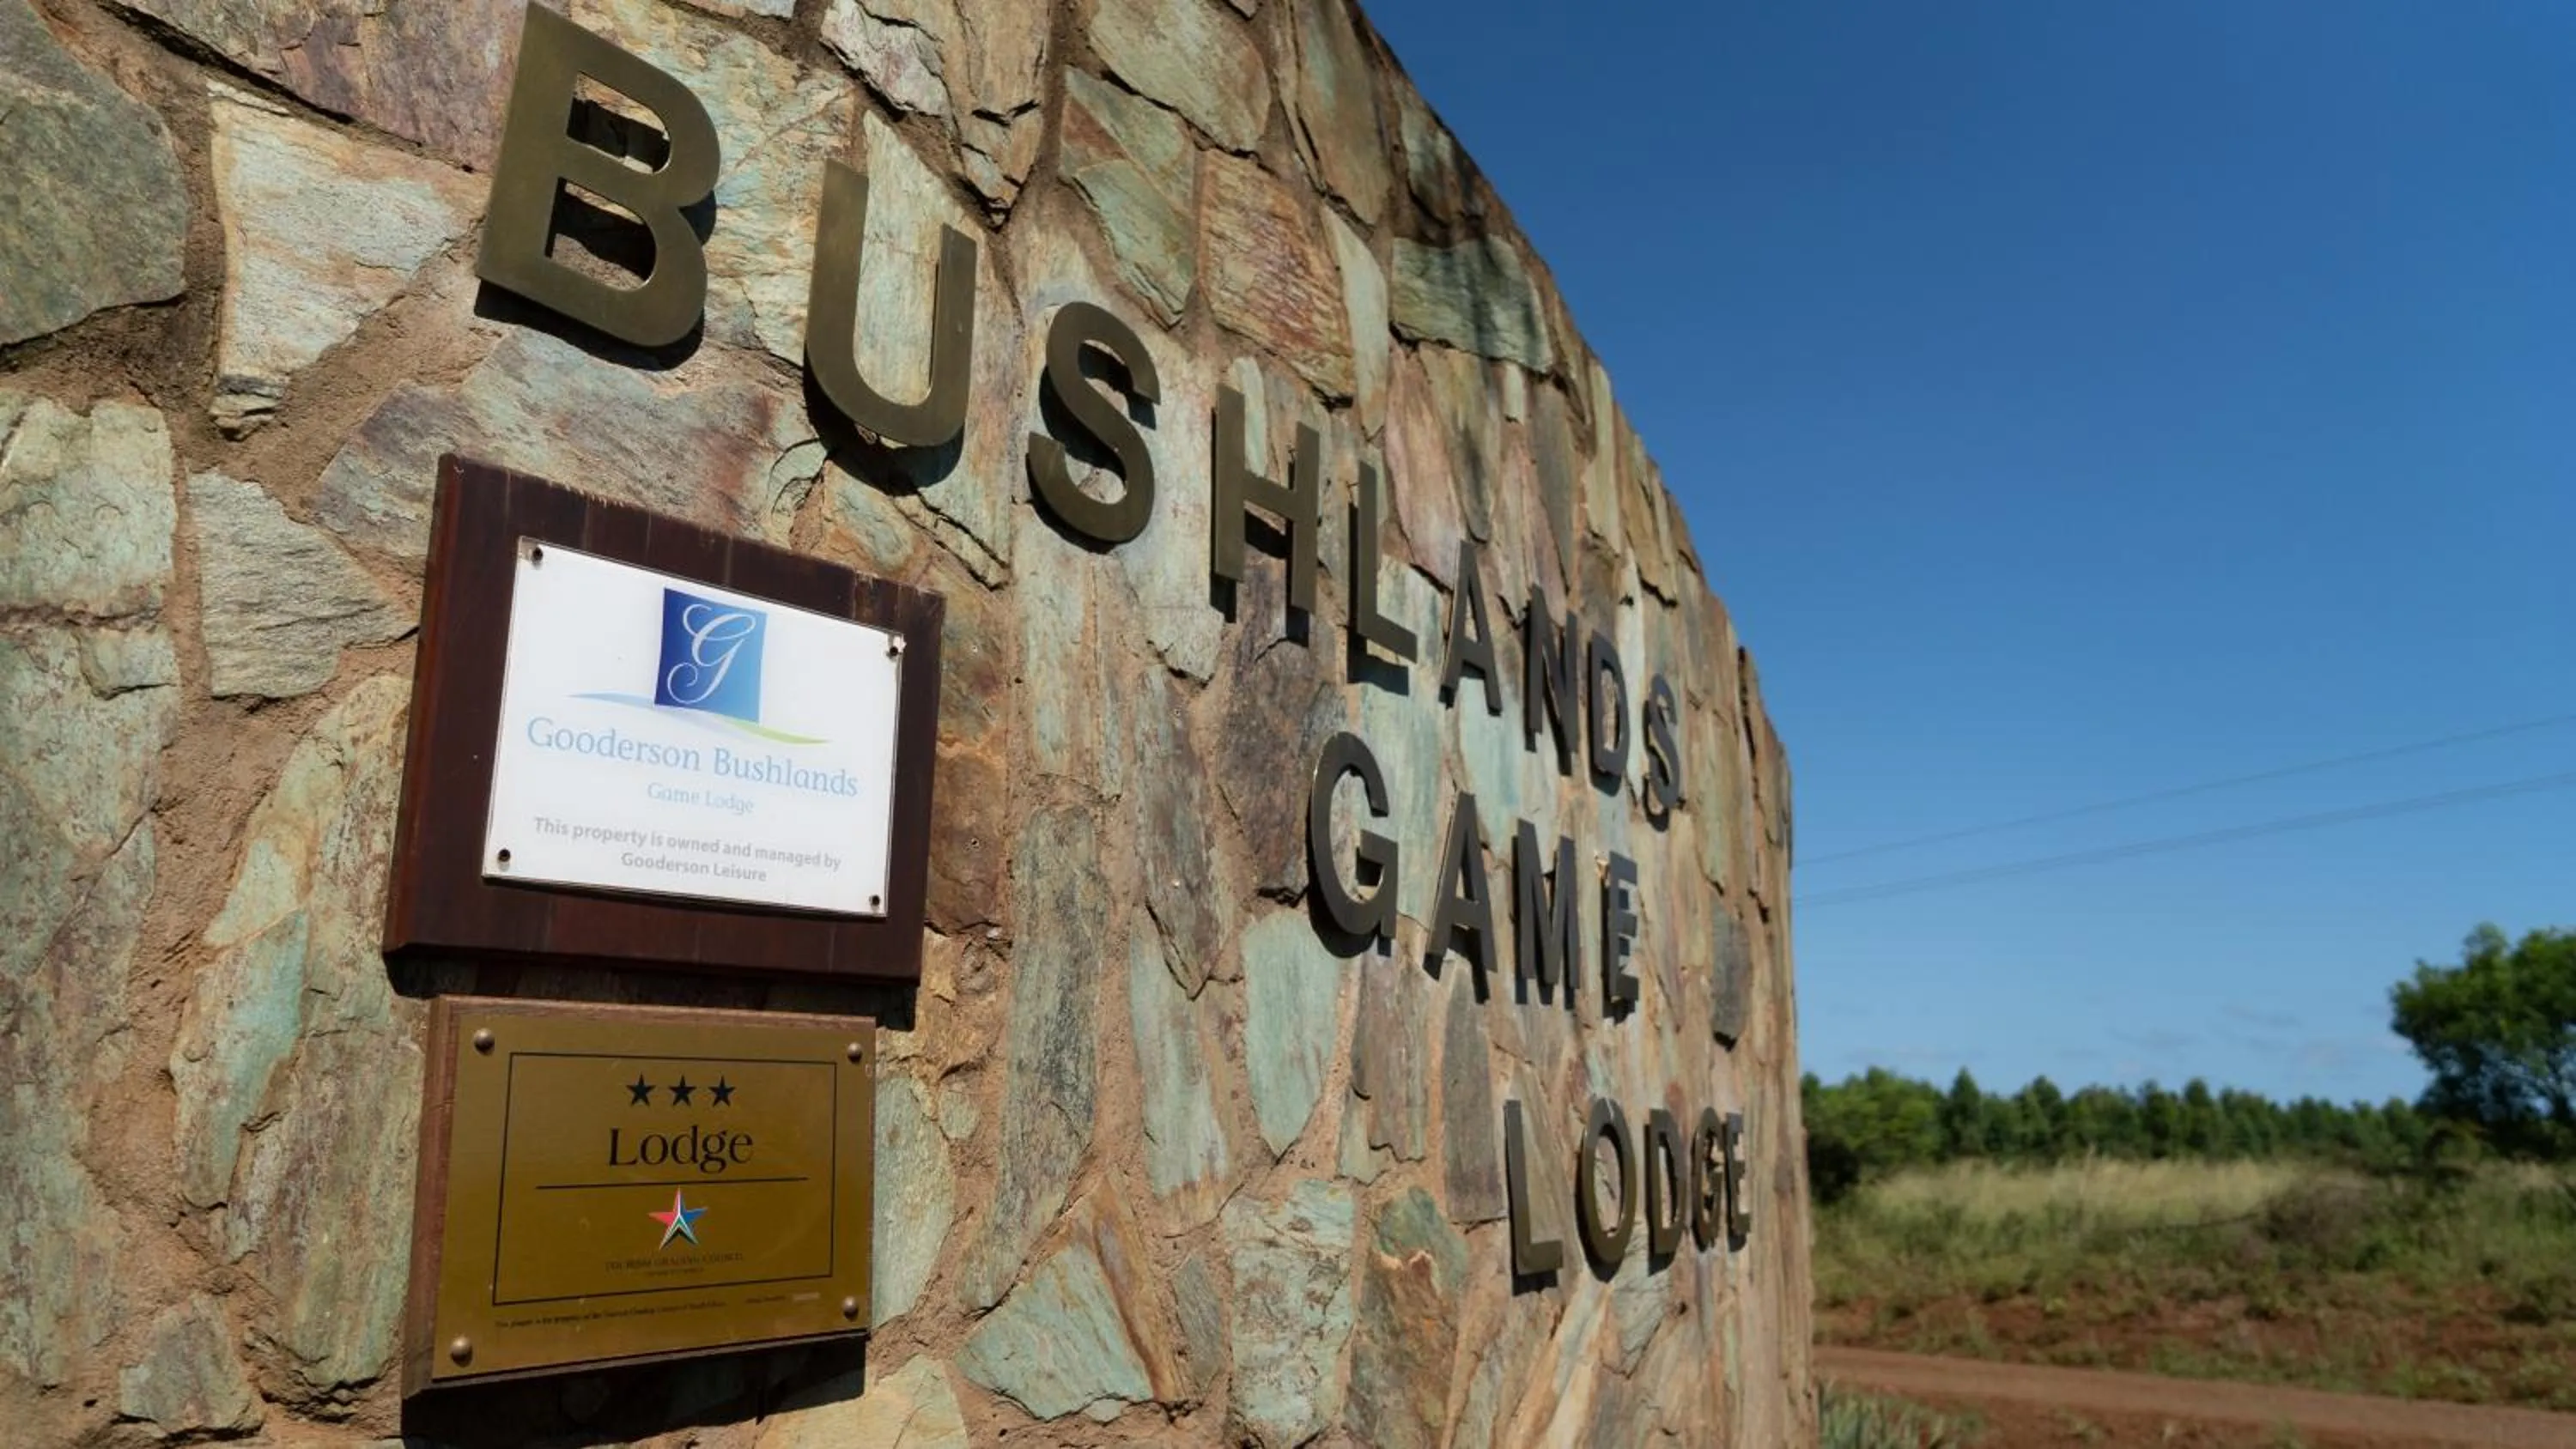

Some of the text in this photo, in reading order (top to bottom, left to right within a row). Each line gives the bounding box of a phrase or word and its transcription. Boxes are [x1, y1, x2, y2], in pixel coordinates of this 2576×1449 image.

[477, 3, 1680, 809] BUSHLANDS
[527, 717, 858, 797] Gooderson Bushlands
[647, 782, 754, 815] Game Lodge
[535, 816, 841, 872] This property is owned and managed by
[621, 852, 768, 882] Gooderson Leisure
[1311, 730, 1639, 998] GAME
[609, 1125, 753, 1173] Lodge
[1504, 1098, 1750, 1276] LODGE
